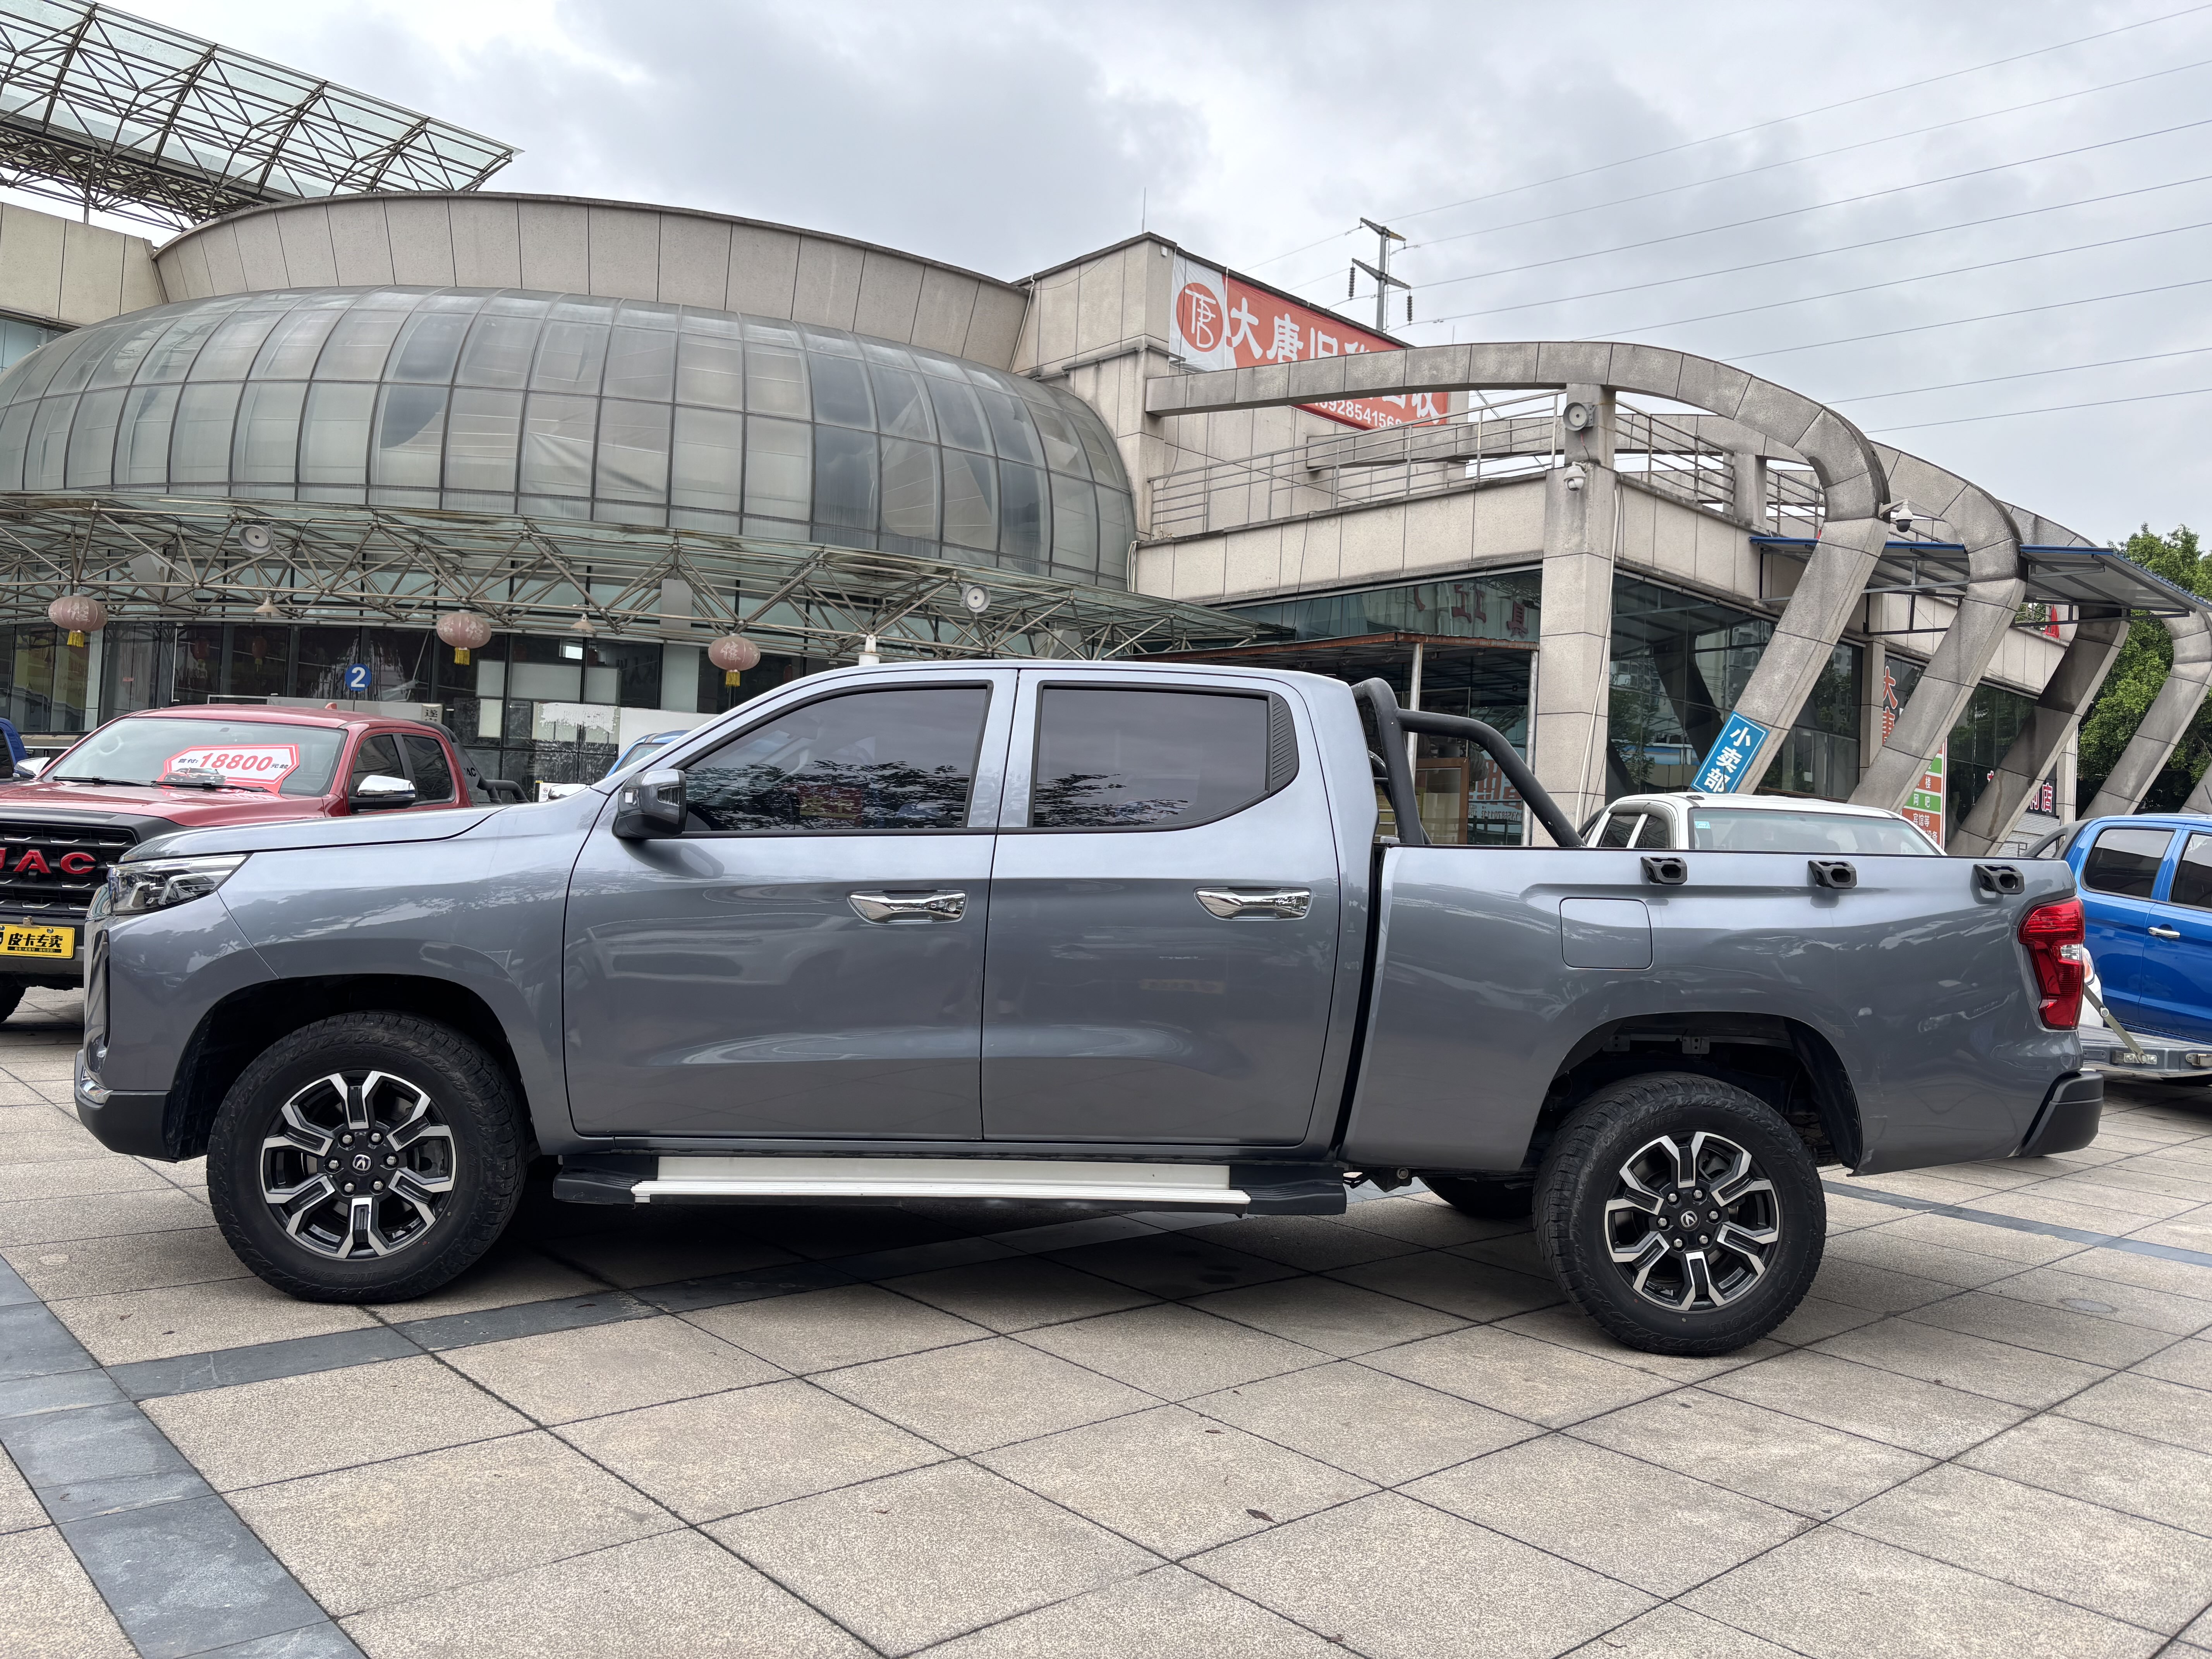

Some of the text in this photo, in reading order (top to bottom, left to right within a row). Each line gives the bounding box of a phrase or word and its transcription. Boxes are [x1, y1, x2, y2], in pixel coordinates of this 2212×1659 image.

[1315, 400, 1402, 428] 92854156
[351, 667, 366, 688] 2
[200, 753, 273, 771] 18800
[1704, 726, 1750, 793] 小卖部
[1913, 793, 1930, 808] 网吧
[1913, 812, 1930, 827] 宾馆等
[1923, 830, 1937, 843] 设备
[8, 933, 63, 948] 皮卡专卖
[301, 1047, 410, 1069] CROSSWIND
[1601, 1112, 1683, 1174] CROSSWIND
[298, 1265, 388, 1283] LINGLONG
[1710, 1288, 1778, 1334] LINGLONG
